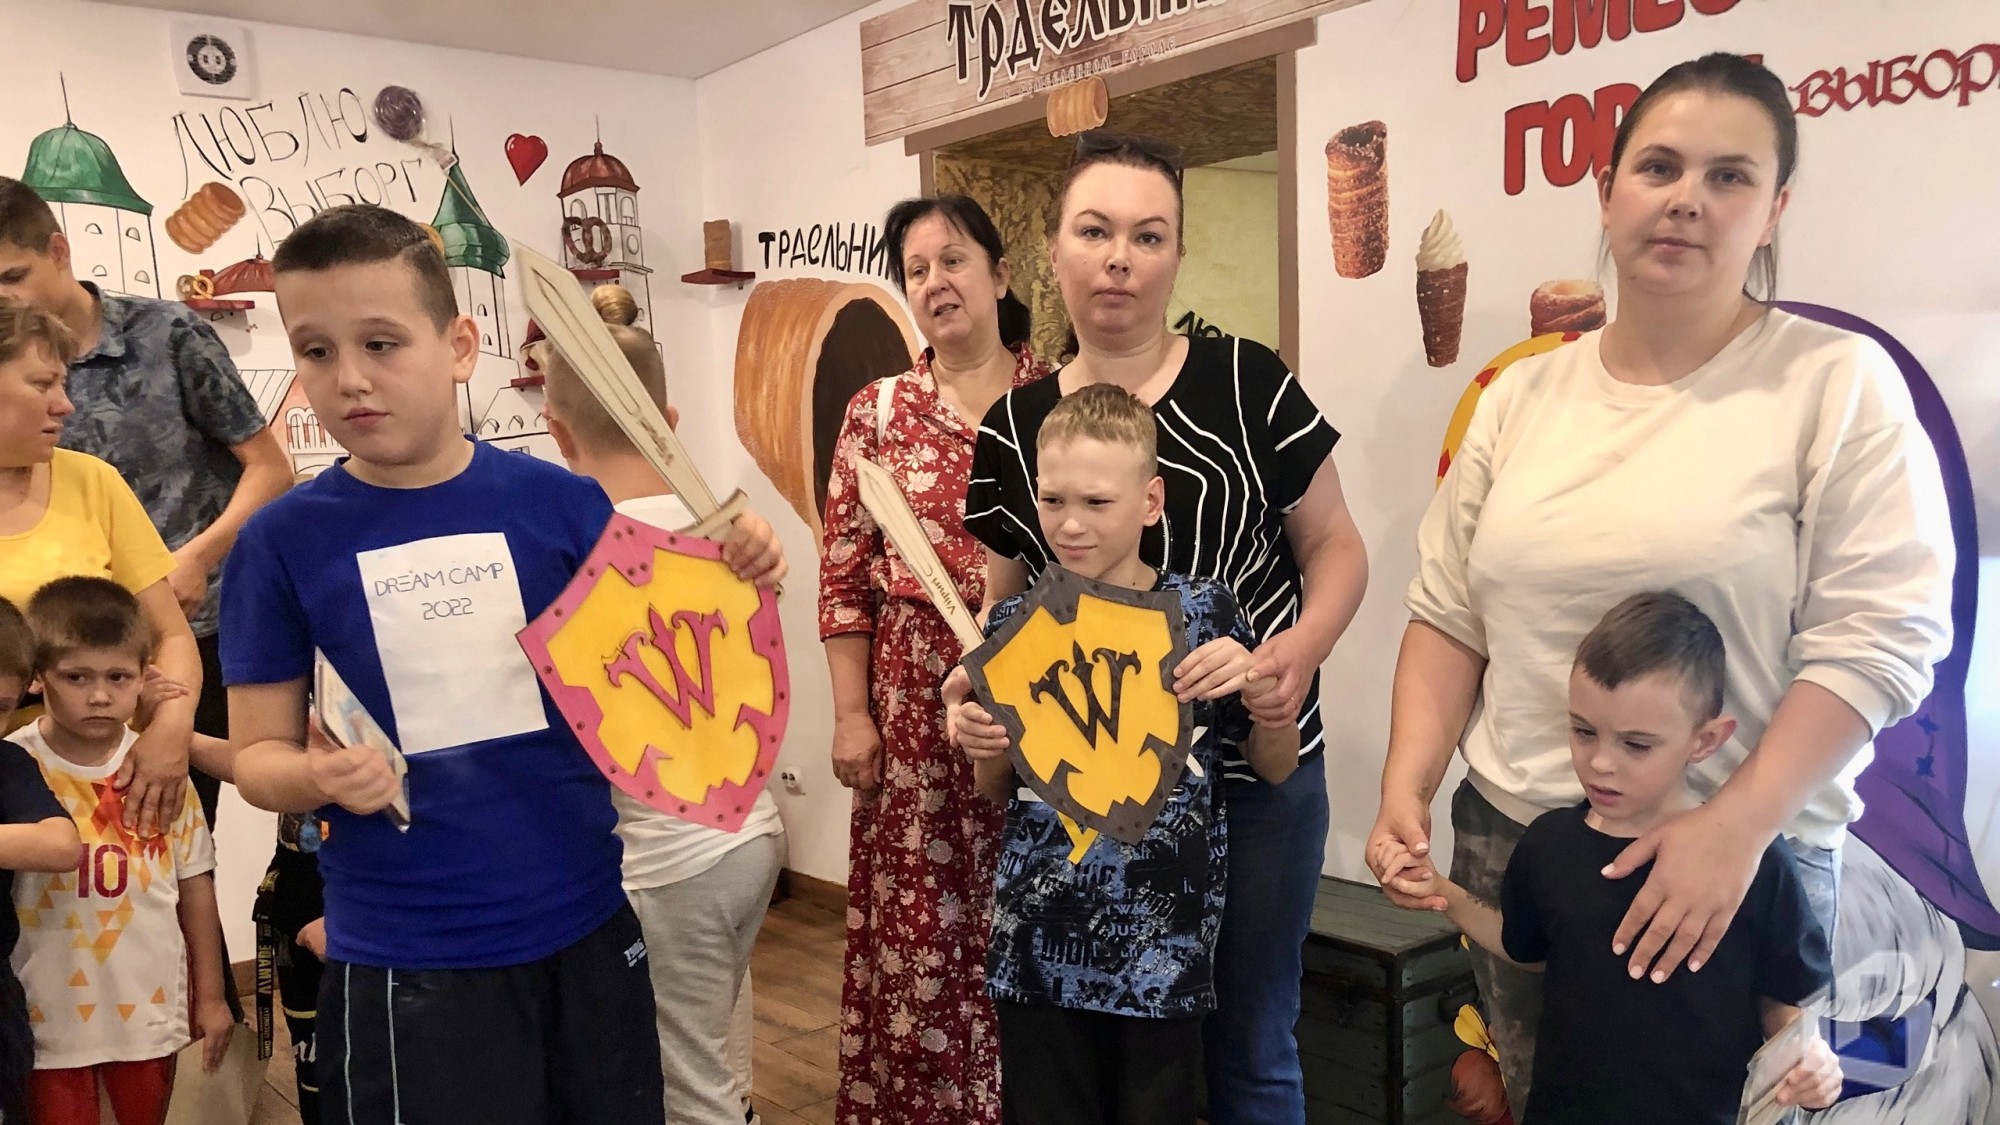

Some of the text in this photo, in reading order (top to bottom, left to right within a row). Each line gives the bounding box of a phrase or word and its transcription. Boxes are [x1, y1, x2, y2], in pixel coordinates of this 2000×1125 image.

[1788, 43, 2000, 118] ВЫБОР
[171, 87, 368, 201] ЛЮБЛЮ
[374, 562, 504, 597] DREAM CAMP
[421, 597, 474, 620] 2022
[602, 602, 729, 731] W
[1029, 639, 1142, 751] W
[78, 842, 128, 898] 10
